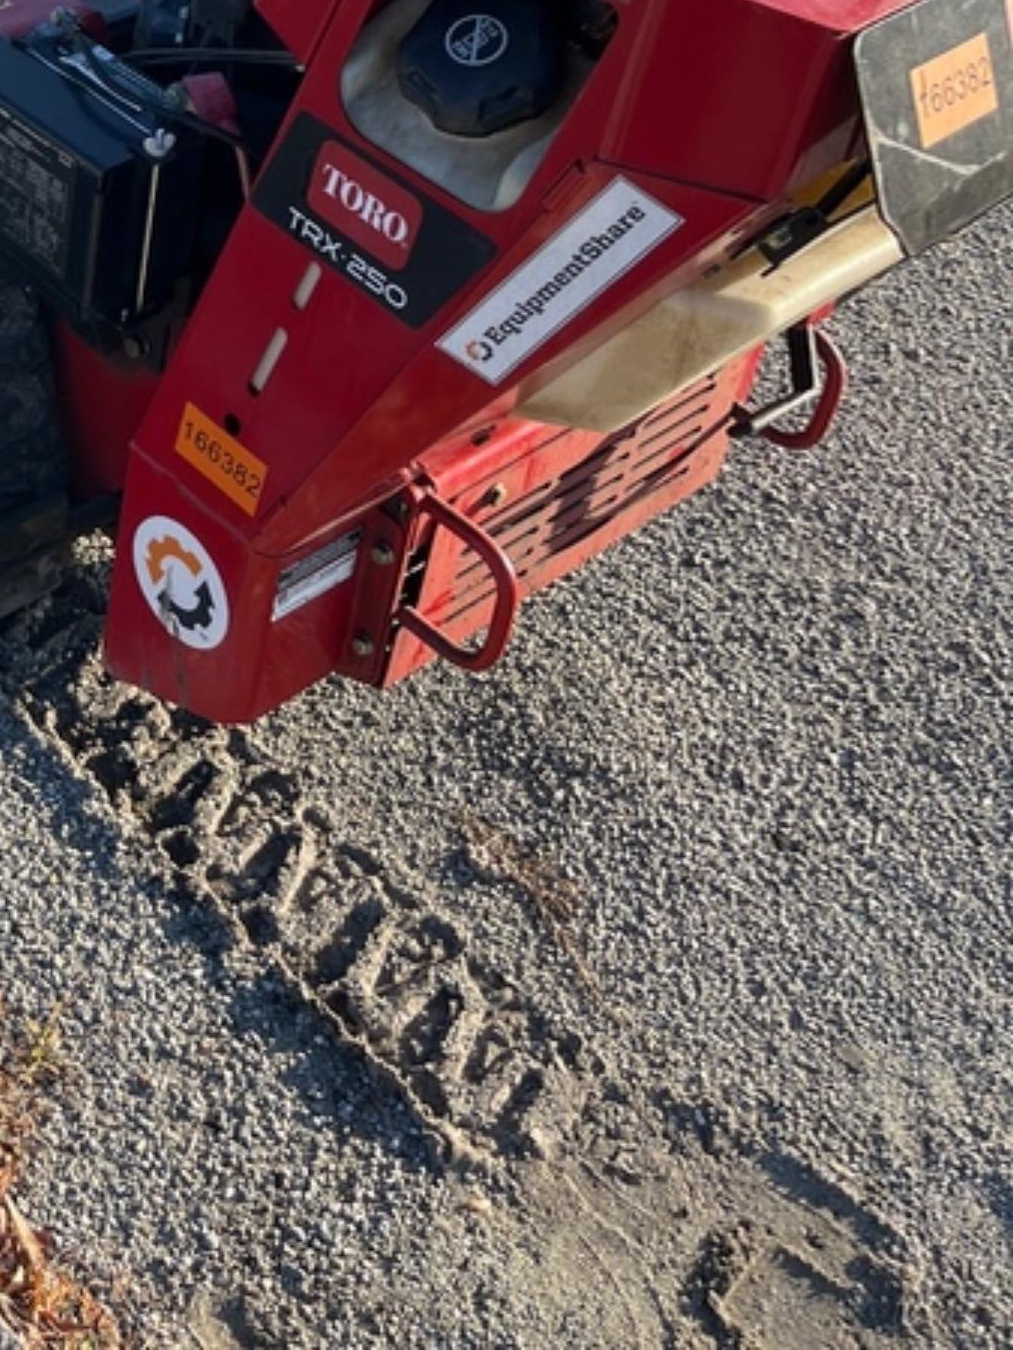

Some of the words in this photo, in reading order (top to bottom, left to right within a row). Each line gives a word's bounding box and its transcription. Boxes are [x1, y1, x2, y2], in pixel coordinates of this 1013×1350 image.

[919, 56, 991, 117] 166382
[322, 164, 408, 242] TORO
[483, 205, 646, 345] EquipmentShare
[185, 422, 261, 497] 166382
